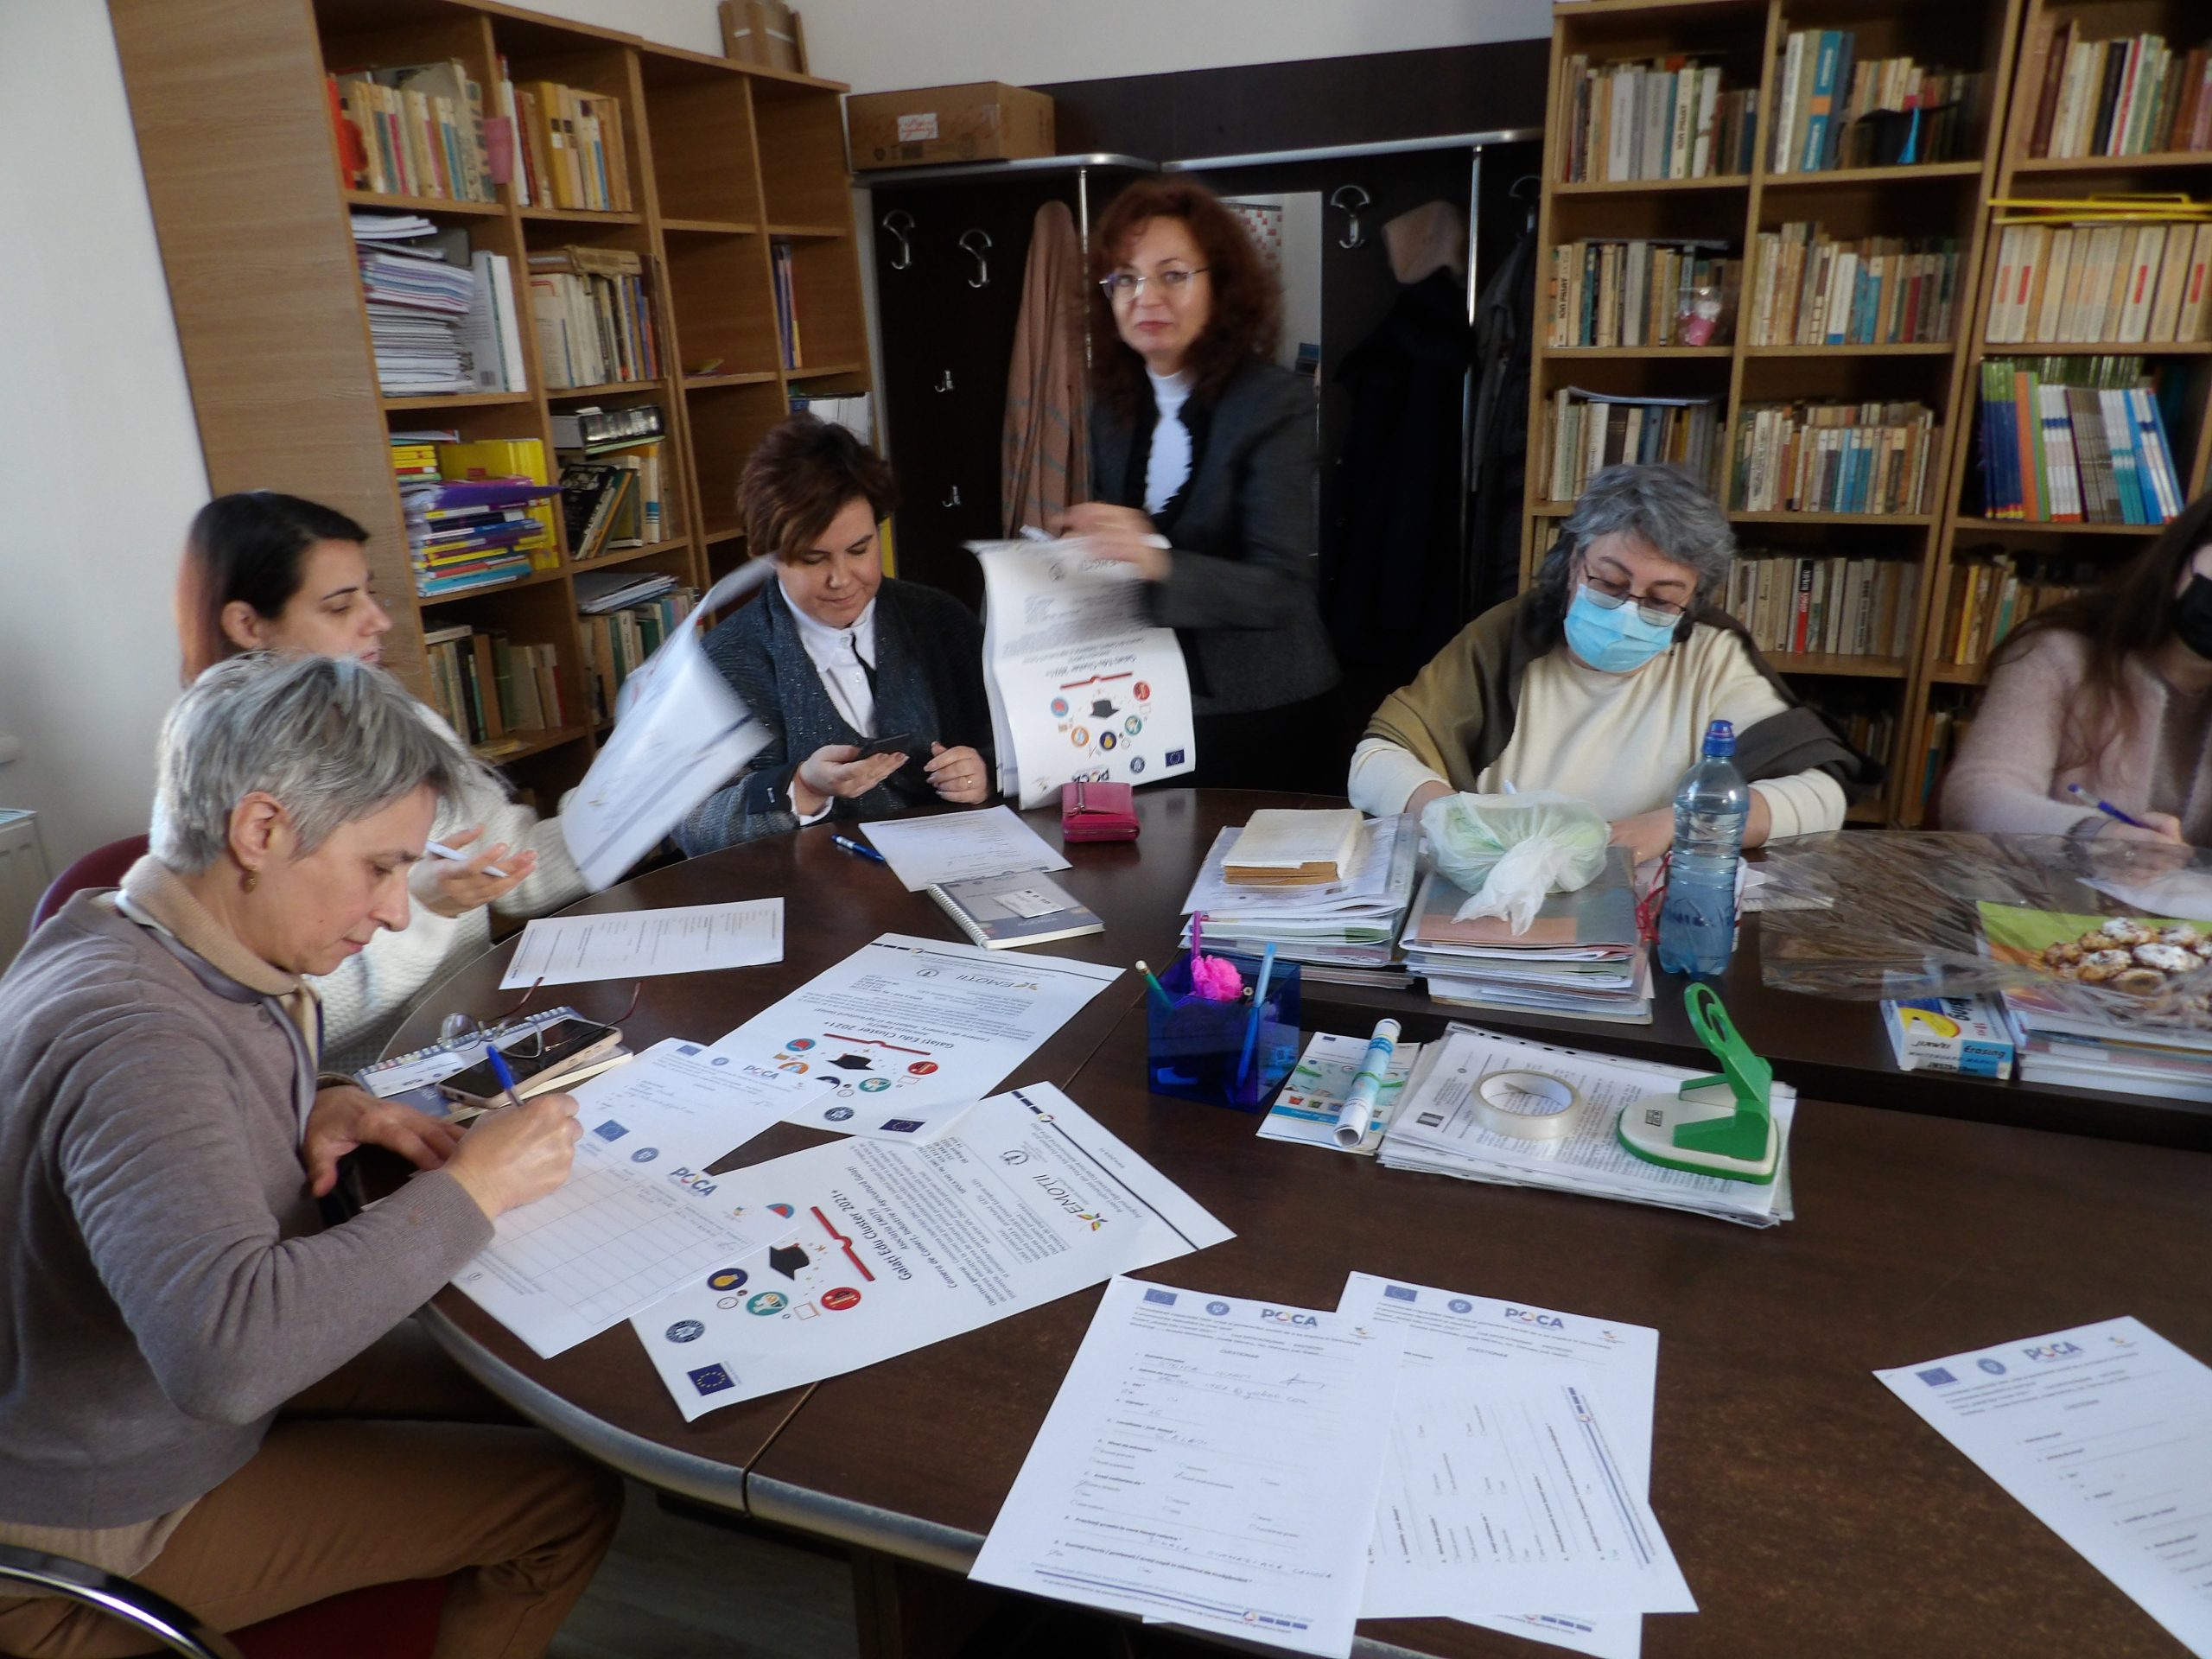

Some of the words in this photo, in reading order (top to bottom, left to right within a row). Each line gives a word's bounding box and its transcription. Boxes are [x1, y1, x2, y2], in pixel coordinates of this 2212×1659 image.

[855, 1027, 898, 1038] Cluster
[895, 1033, 921, 1043] Edu
[918, 1038, 957, 1049] Galați
[1964, 1045, 2005, 1058] Erasing
[743, 1065, 780, 1080] POCA
[671, 1166, 720, 1198] POCA
[826, 1188, 855, 1211] 2021+
[1029, 1172, 1089, 1215] EMOȚII
[846, 1211, 880, 1240] Cluster
[868, 1238, 893, 1256] Edu
[882, 1253, 918, 1281] Galați
[924, 1256, 938, 1265] de
[931, 1264, 960, 1289] Camera
[1261, 1308, 1319, 1327] POCA
[1504, 1307, 1565, 1329] POCA
[2022, 1342, 2082, 1361] POCA
